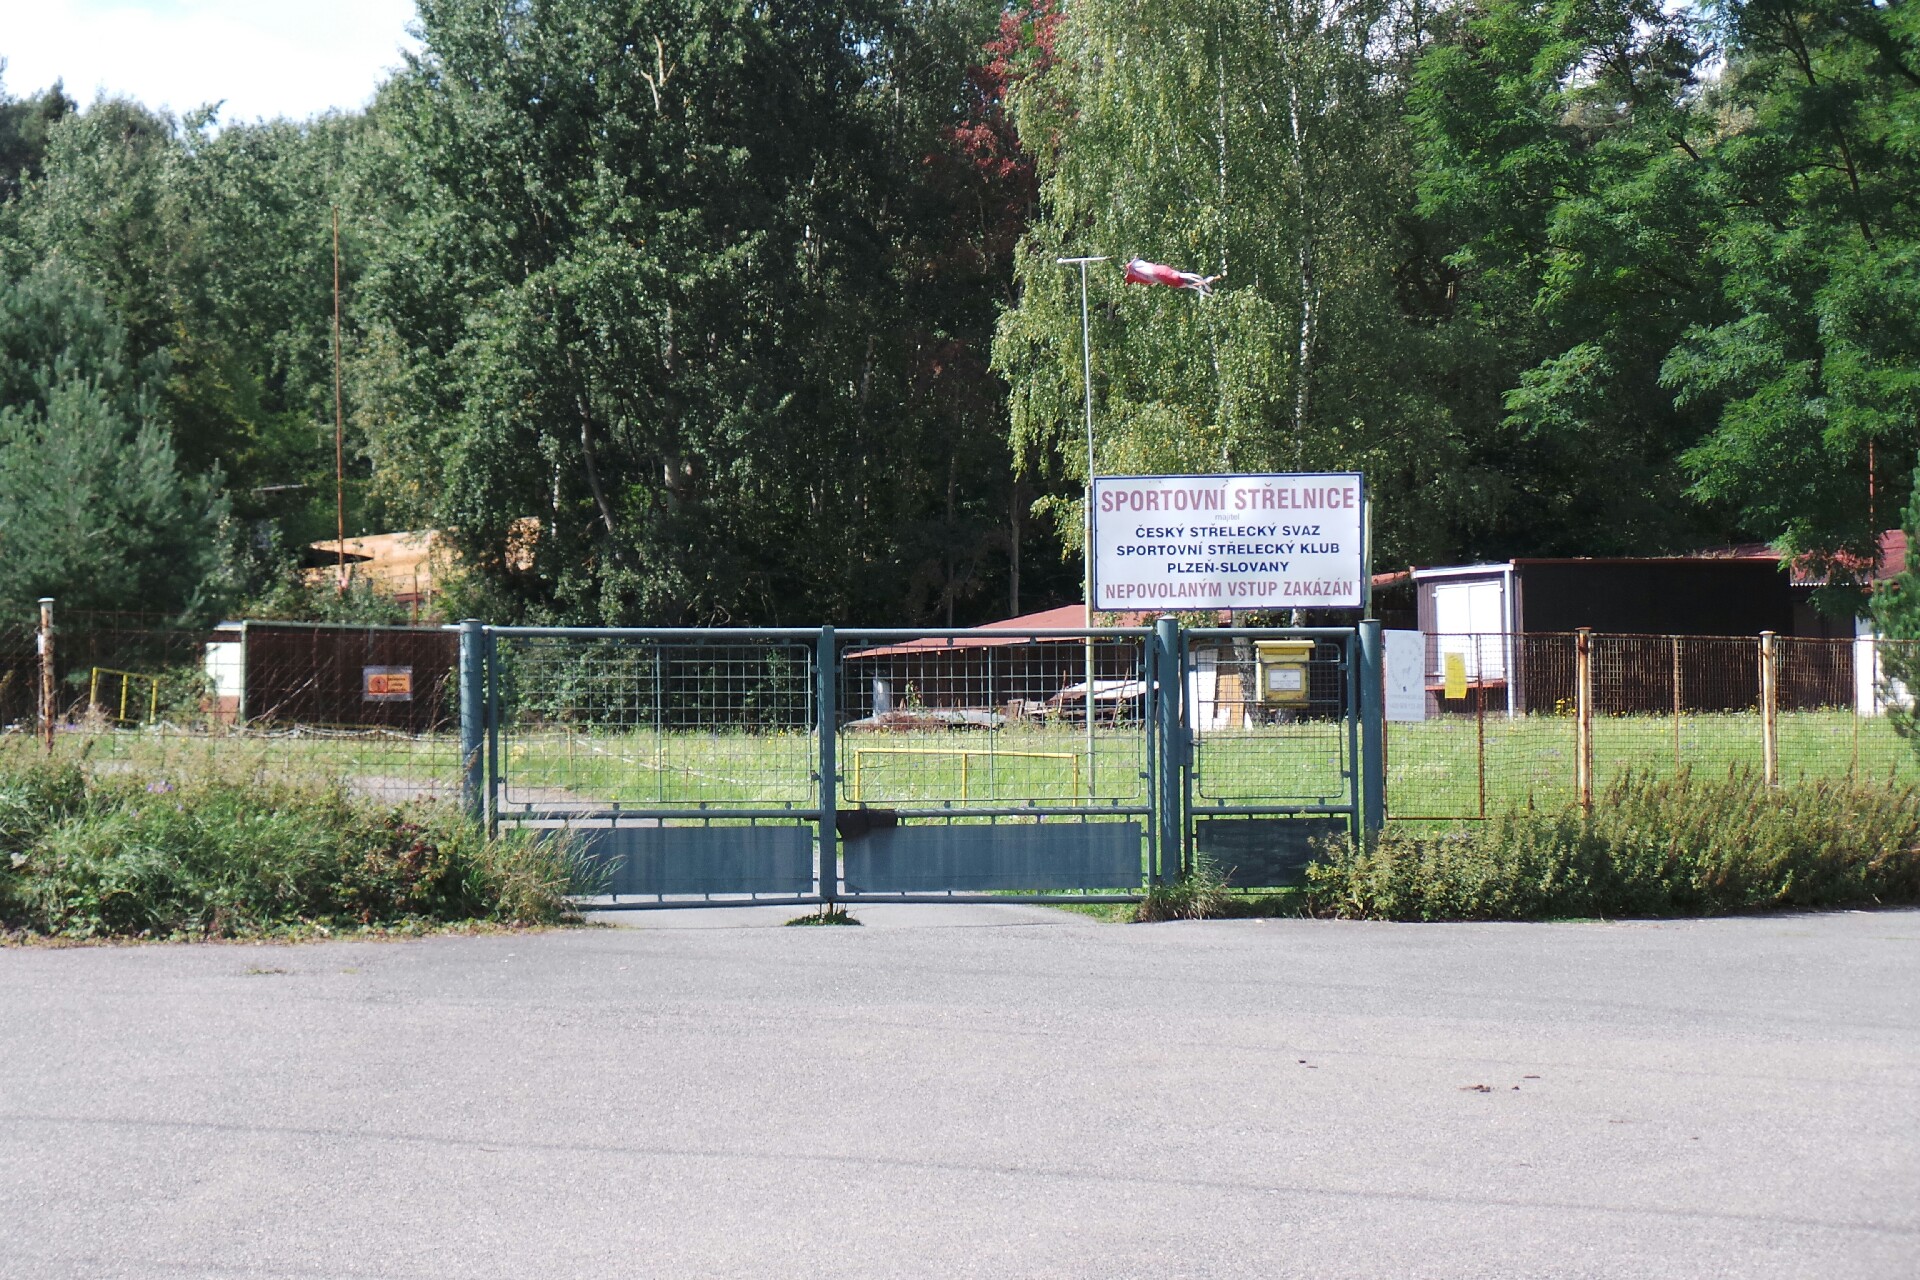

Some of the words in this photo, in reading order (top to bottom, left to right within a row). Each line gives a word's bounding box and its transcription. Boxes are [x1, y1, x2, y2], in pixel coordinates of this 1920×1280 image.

[1101, 484, 1226, 512] SPORTOVNÍ
[1234, 483, 1354, 510] STŘELNICE
[1215, 513, 1240, 522] majitel
[1136, 524, 1184, 538] ČESKÝ
[1189, 523, 1277, 537] STŘELECKÝ
[1282, 525, 1320, 536] SVAZ
[1116, 542, 1202, 555] SPORTOVNÍ
[1208, 541, 1295, 554] STŘELECKÝ
[1300, 543, 1340, 554] KLUB
[1167, 560, 1289, 573] PLZEŇ-SLOVANY
[1105, 579, 1222, 599] NEPOVOLANÝM
[1228, 582, 1278, 596] VSTUP
[1284, 578, 1352, 596] ZAKÁZÁN
